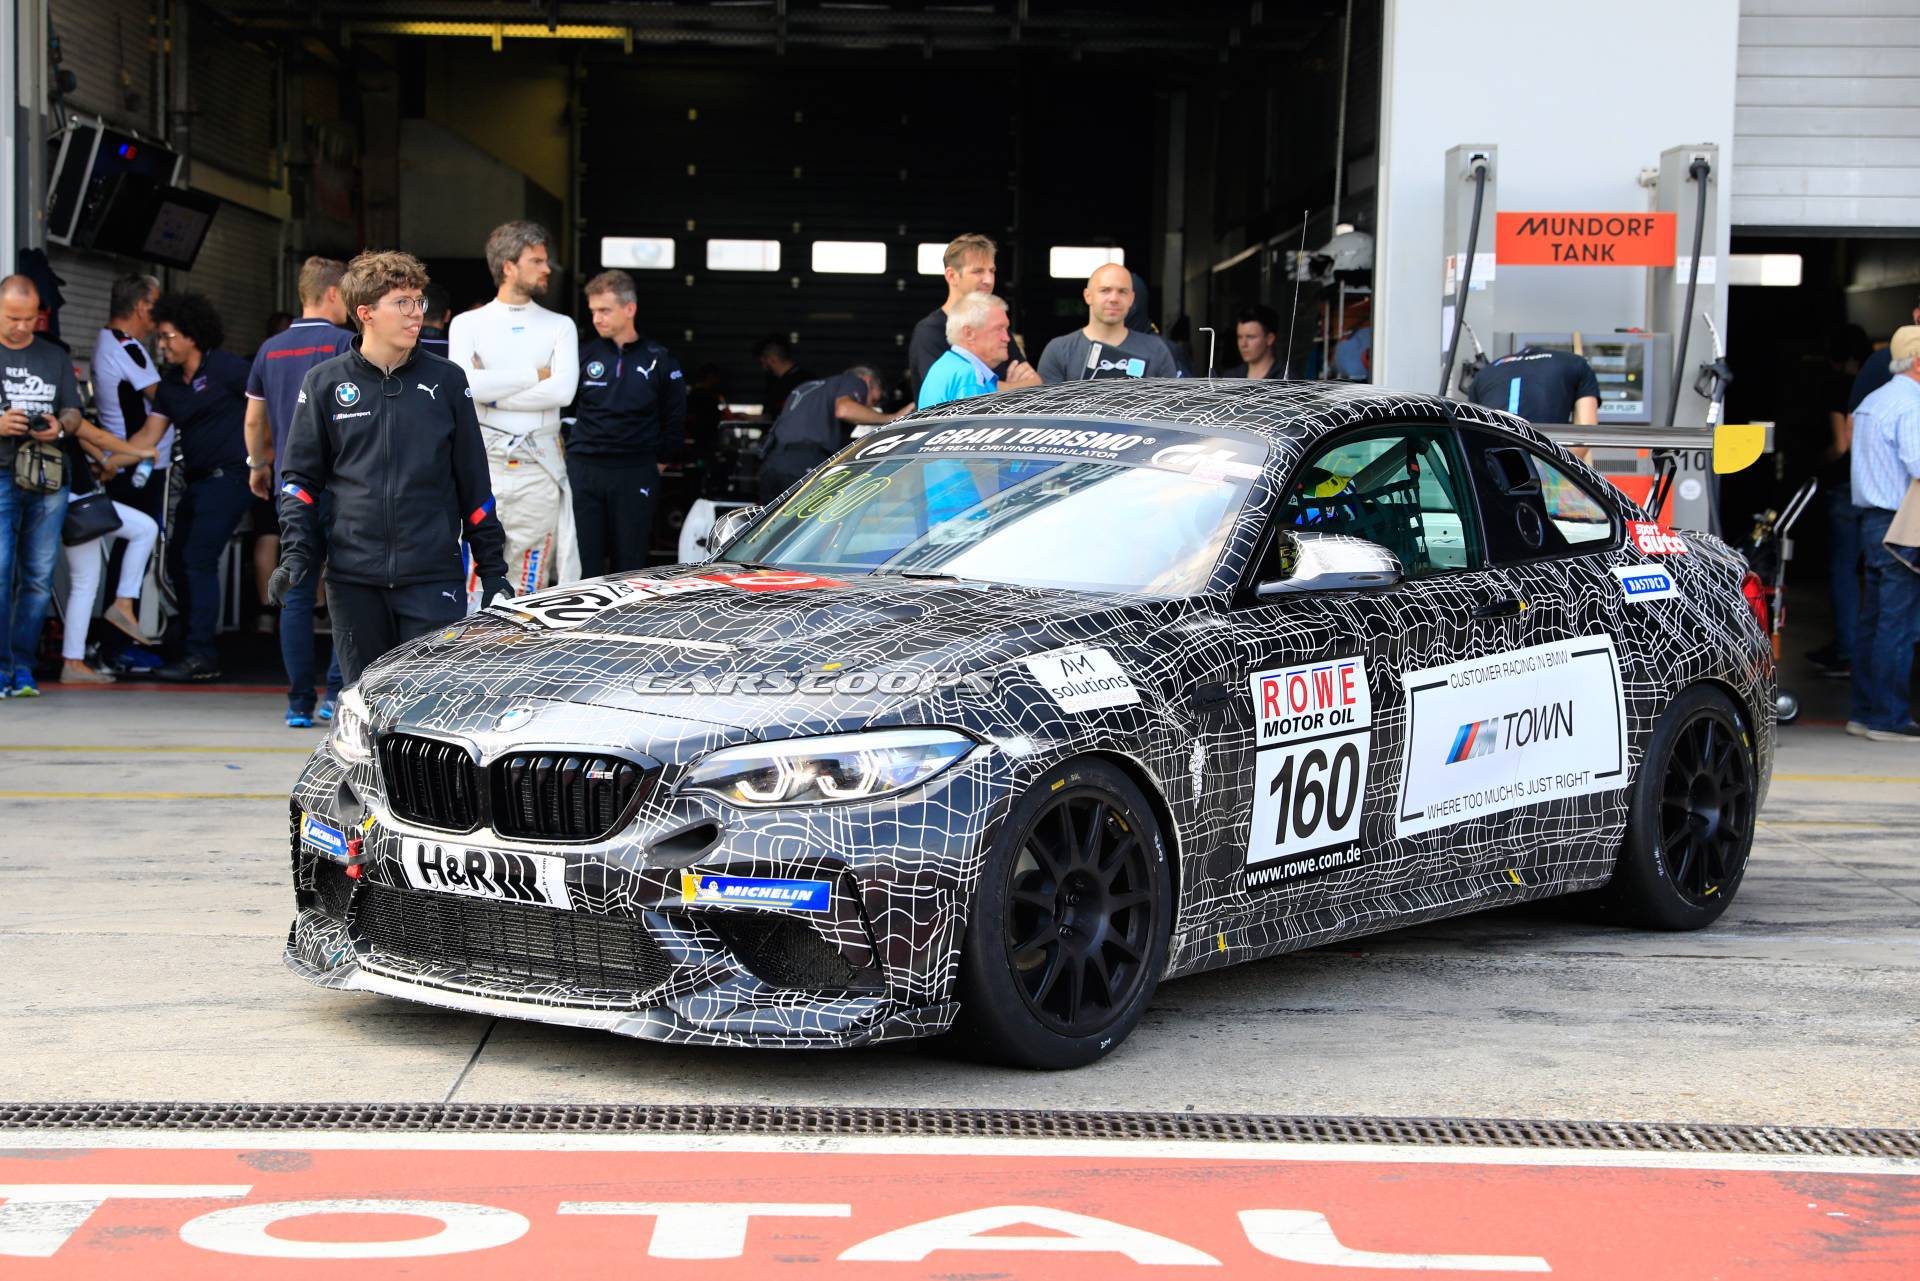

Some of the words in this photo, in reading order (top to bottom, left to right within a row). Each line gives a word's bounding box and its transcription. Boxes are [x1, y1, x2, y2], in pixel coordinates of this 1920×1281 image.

[1516, 217, 1655, 237] MUNDORF
[1551, 243, 1616, 262] TANK
[924, 427, 1013, 446] GRAN
[943, 444, 976, 452] REAL
[980, 444, 1034, 453] DRIVING
[1036, 446, 1118, 459] SIMULATOR
[1680, 452, 1706, 472] 10
[1635, 524, 1660, 535] sport
[1638, 534, 1689, 553] auto
[1628, 577, 1666, 592] BASTUCK
[1450, 664, 1503, 689] CUSTOMER
[1503, 656, 1536, 677] RACING
[1546, 649, 1569, 667] BMW
[1051, 675, 1130, 699] solutions
[1261, 664, 1357, 719] ROWE
[1263, 713, 1324, 738] MOTOR
[1329, 708, 1355, 726] OIL
[1503, 699, 1573, 750] TOWN
[1270, 742, 1360, 845] 160
[1427, 798, 1462, 820] WHERE
[1464, 792, 1484, 809] TOO
[1485, 785, 1513, 804] MUCH
[1527, 777, 1553, 795] JUST
[1556, 771, 1591, 789] RIGHT
[416, 842, 504, 898] H&R
[1246, 844, 1361, 886] www.rowe.com.de
[724, 886, 814, 901] MICHELIN
[0, 1184, 1552, 1273] TOTAL
